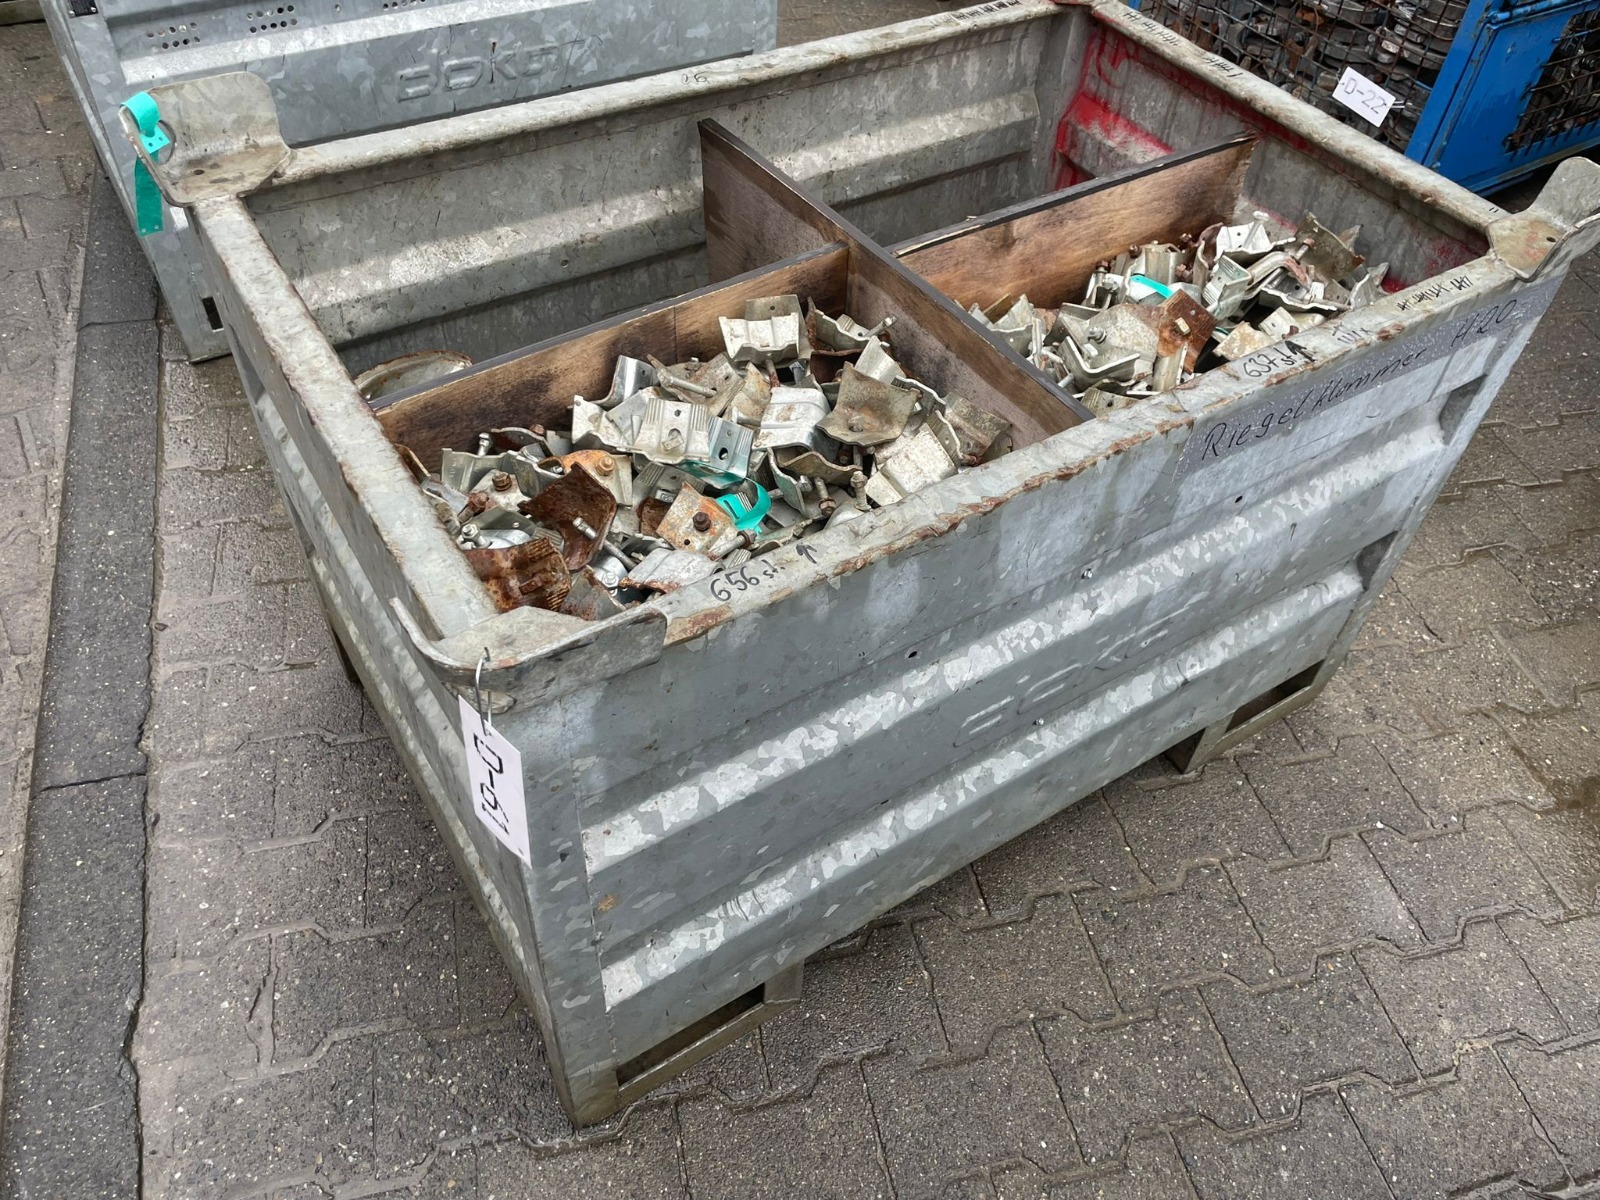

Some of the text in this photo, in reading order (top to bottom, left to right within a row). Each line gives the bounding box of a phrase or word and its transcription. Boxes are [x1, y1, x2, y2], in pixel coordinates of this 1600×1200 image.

[1344, 78, 1387, 114] D-22
[1451, 299, 1518, 348] H20
[1243, 353, 1280, 378] 637
[710, 566, 760, 602] 656
[473, 731, 510, 836] D-61
